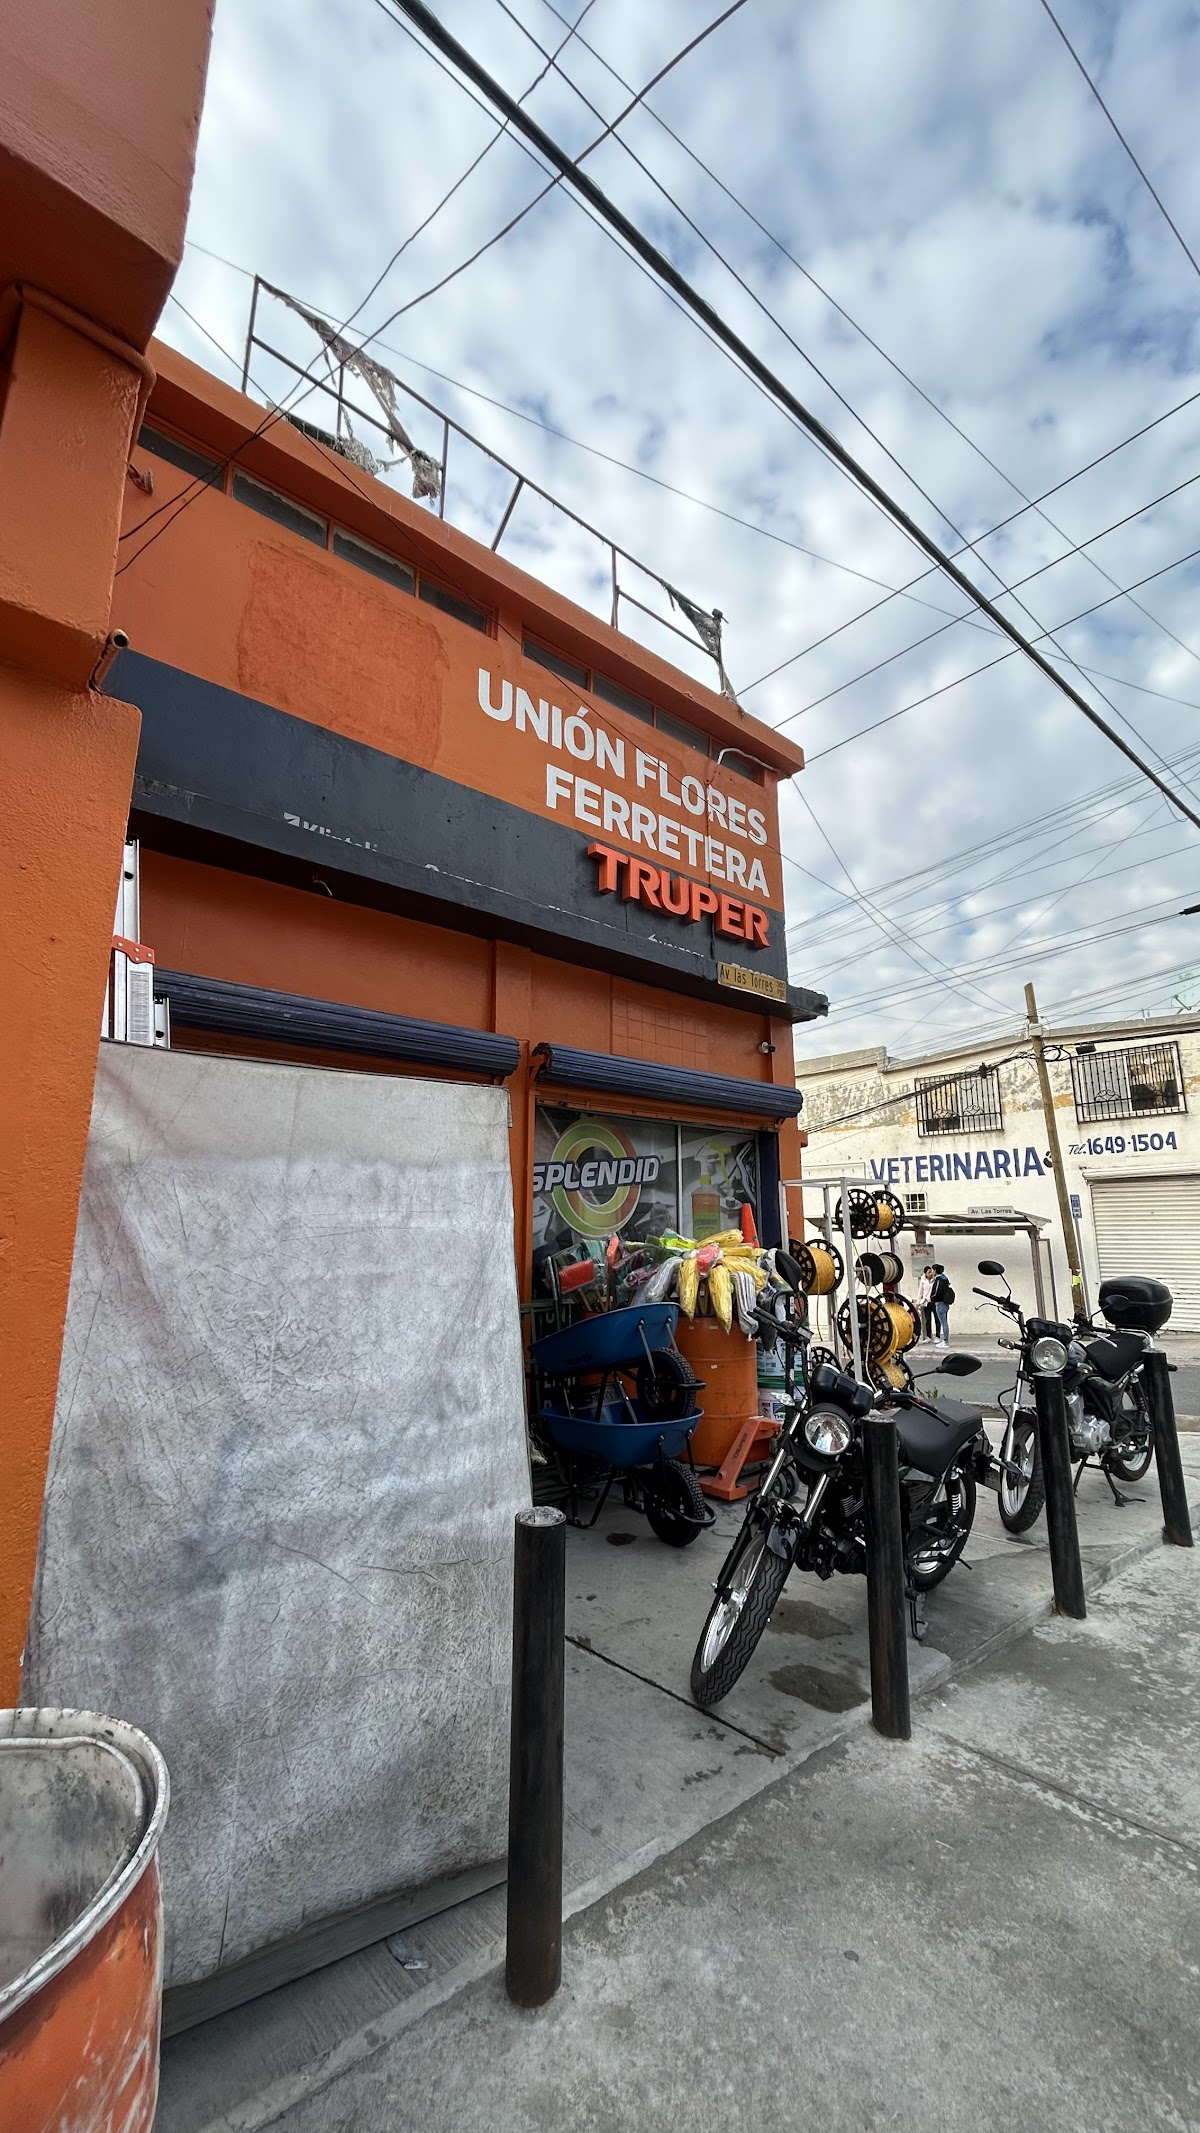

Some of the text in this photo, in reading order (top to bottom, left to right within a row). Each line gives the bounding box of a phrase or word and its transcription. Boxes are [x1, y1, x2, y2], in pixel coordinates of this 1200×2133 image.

[478, 667, 768, 846] UNIÓN FLORES
[546, 763, 770, 898] FERRETERA
[587, 842, 770, 949] TRUPER
[750, 972, 774, 993] Torres
[870, 1146, 1046, 1184] VETERINARIA
[1068, 1143, 1087, 1155] Tel.
[533, 1156, 660, 1192] SPLENDID
